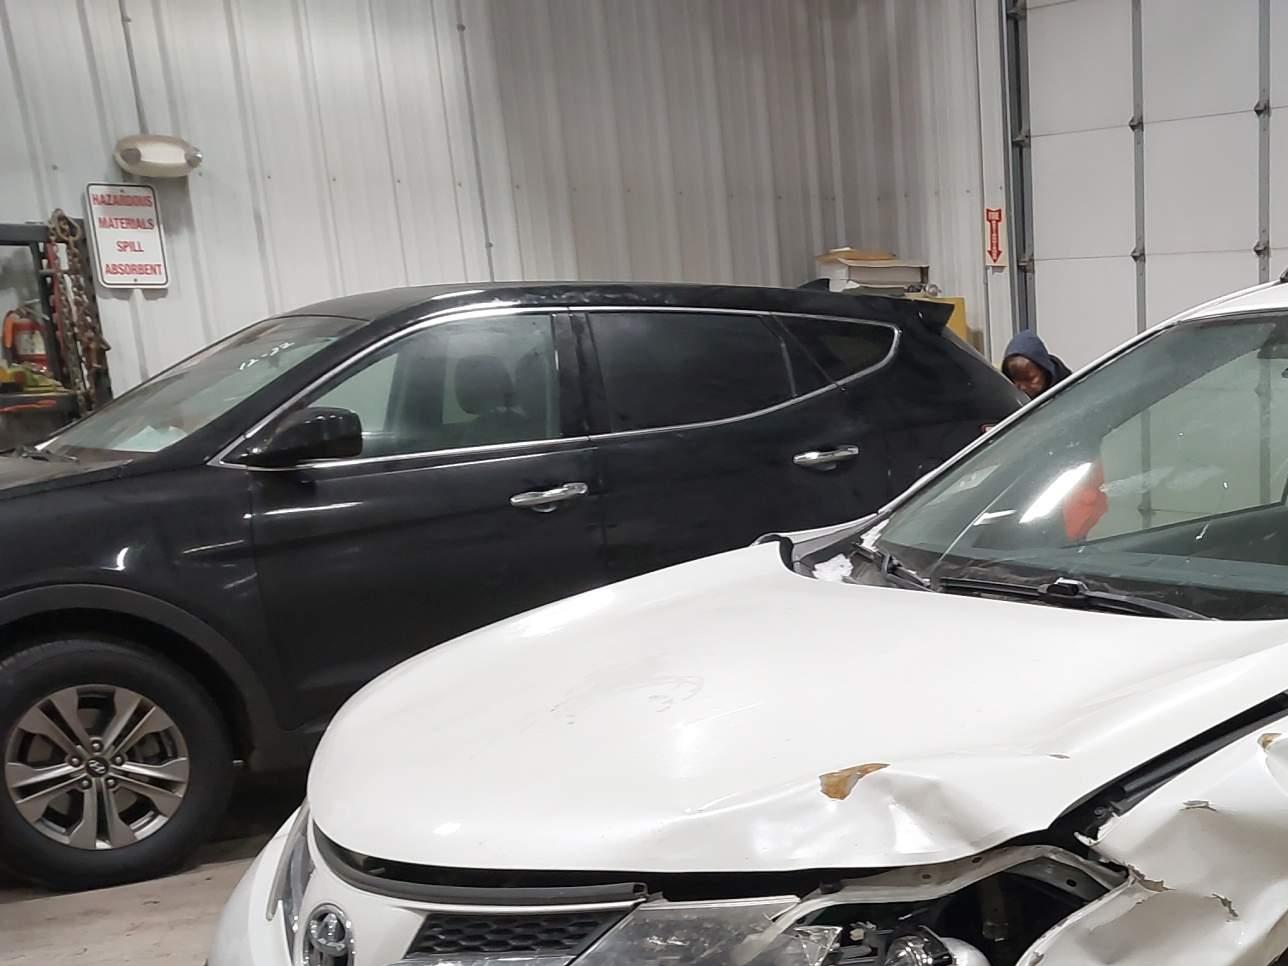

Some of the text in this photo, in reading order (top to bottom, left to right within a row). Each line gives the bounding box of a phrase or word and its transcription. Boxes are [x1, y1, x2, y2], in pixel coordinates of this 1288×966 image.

[91, 194, 153, 207] HAZARDOUS
[98, 217, 155, 230] MATERIALS
[116, 240, 144, 252] SPILL
[105, 263, 162, 275] ABSORBENT
